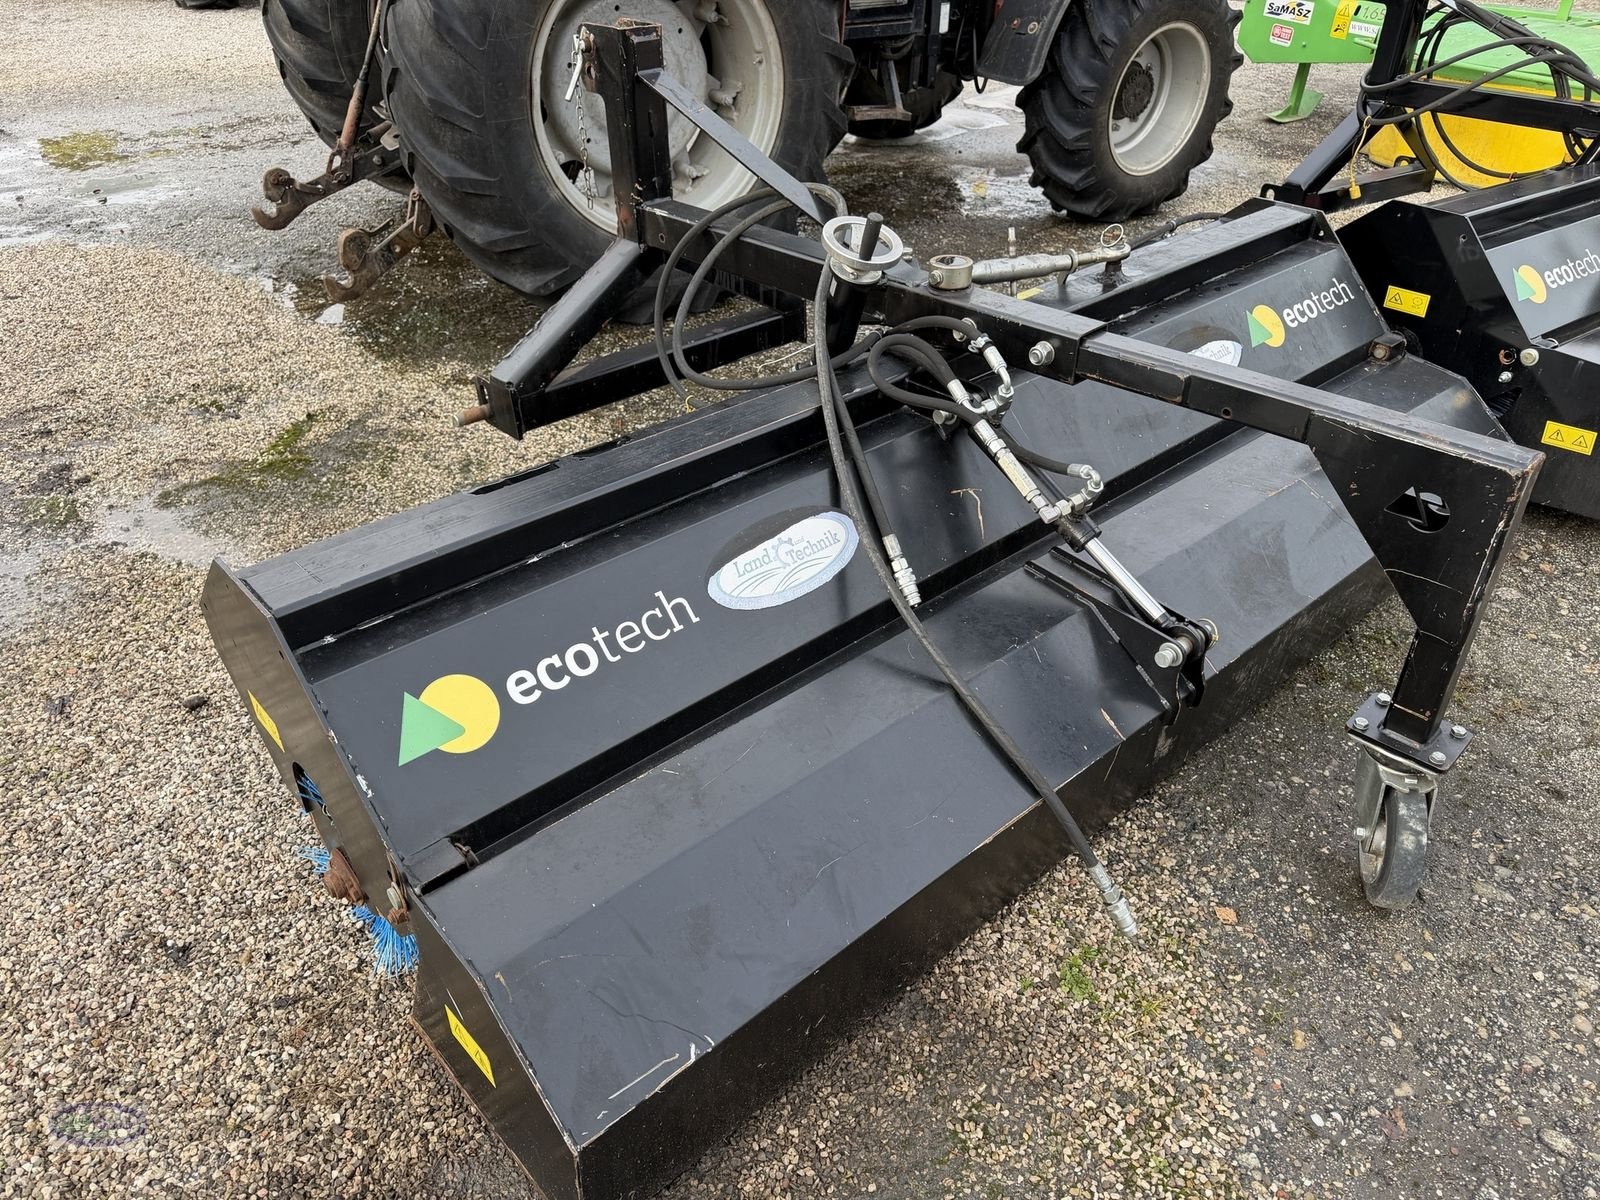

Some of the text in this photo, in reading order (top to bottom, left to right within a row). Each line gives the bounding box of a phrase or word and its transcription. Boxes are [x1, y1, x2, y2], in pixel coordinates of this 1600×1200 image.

[1267, 2, 1311, 18] SaMASZ
[1544, 248, 1600, 289] ecotech
[1282, 277, 1355, 328] ecotech
[733, 548, 773, 577] Land
[785, 530, 841, 565] Technik
[506, 590, 700, 705] ecotech
